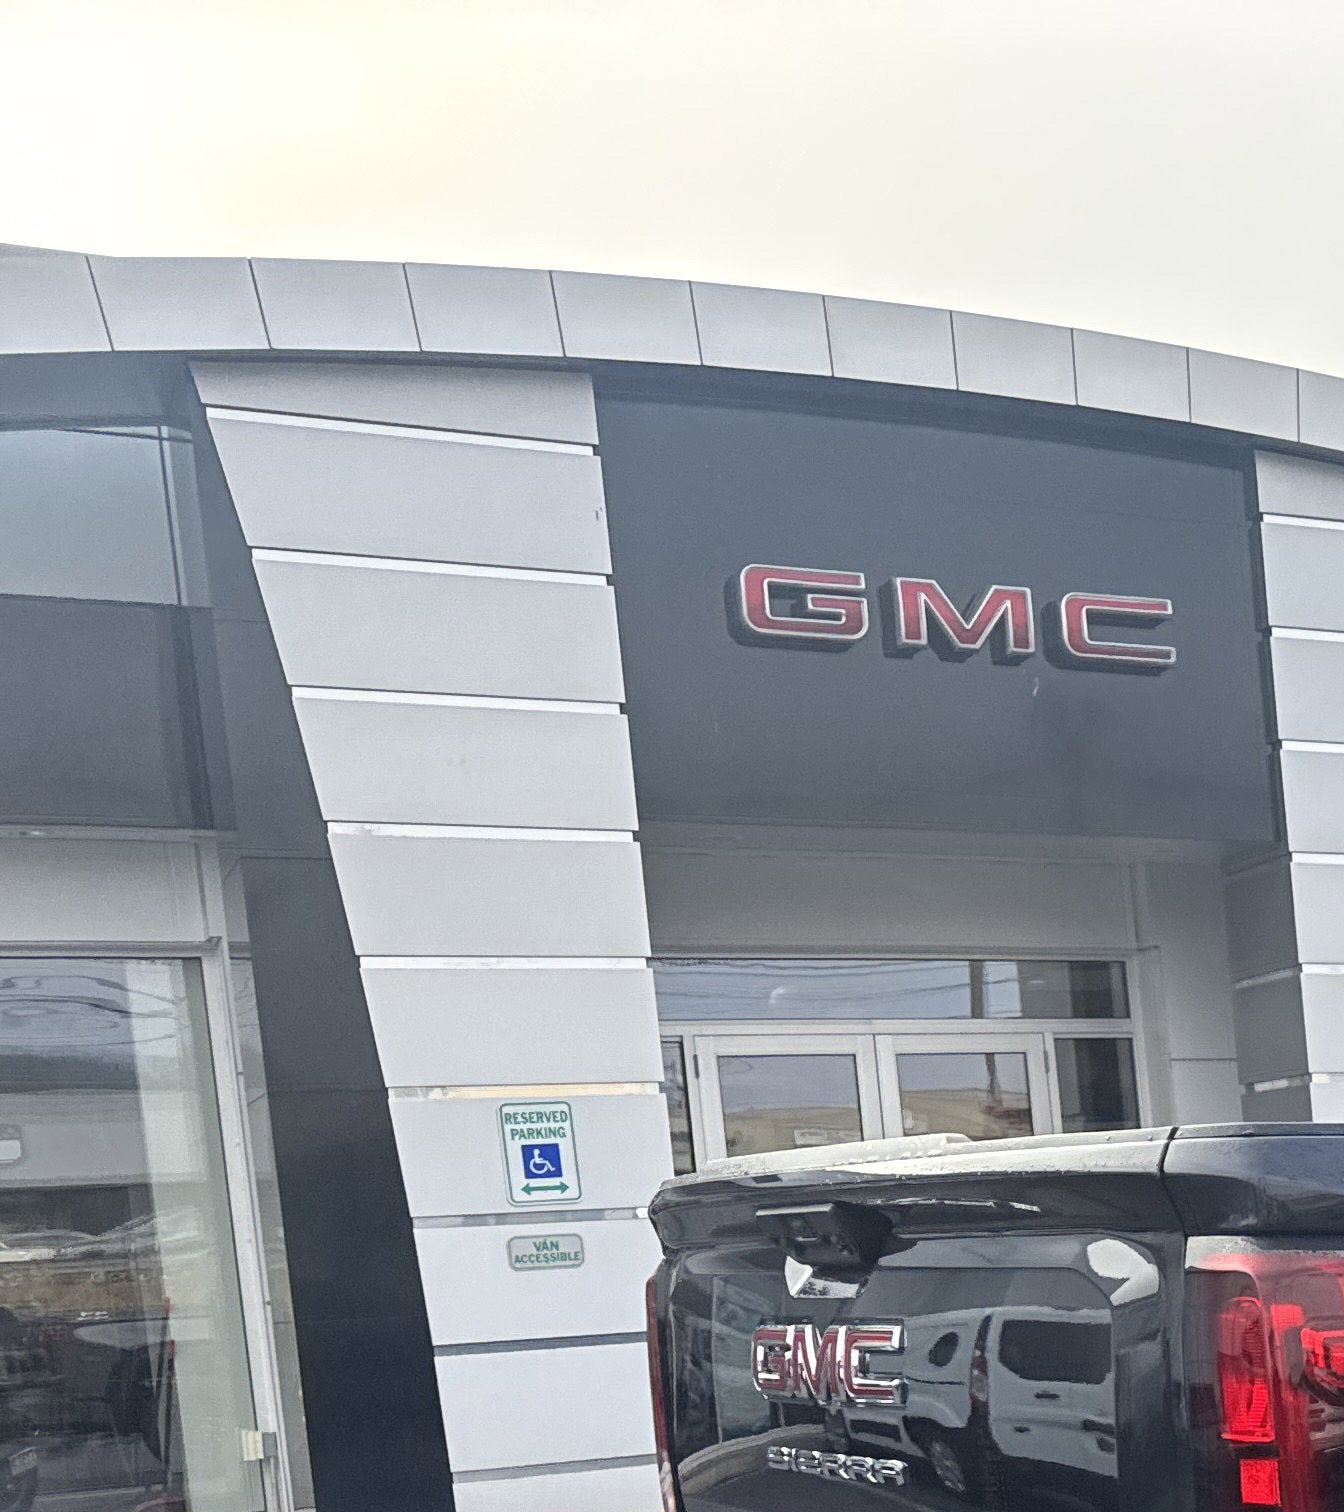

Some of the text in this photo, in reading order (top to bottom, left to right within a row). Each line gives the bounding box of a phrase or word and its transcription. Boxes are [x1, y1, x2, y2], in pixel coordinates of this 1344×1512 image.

[736, 563, 1178, 664] GMC
[504, 1111, 568, 1125] RESERVED
[511, 1127, 566, 1140] PARKING
[533, 1240, 559, 1251] VAN
[514, 1251, 580, 1264] ACCESSIBLE
[752, 1322, 910, 1407] GMC
[767, 1446, 909, 1486] SIERRA
